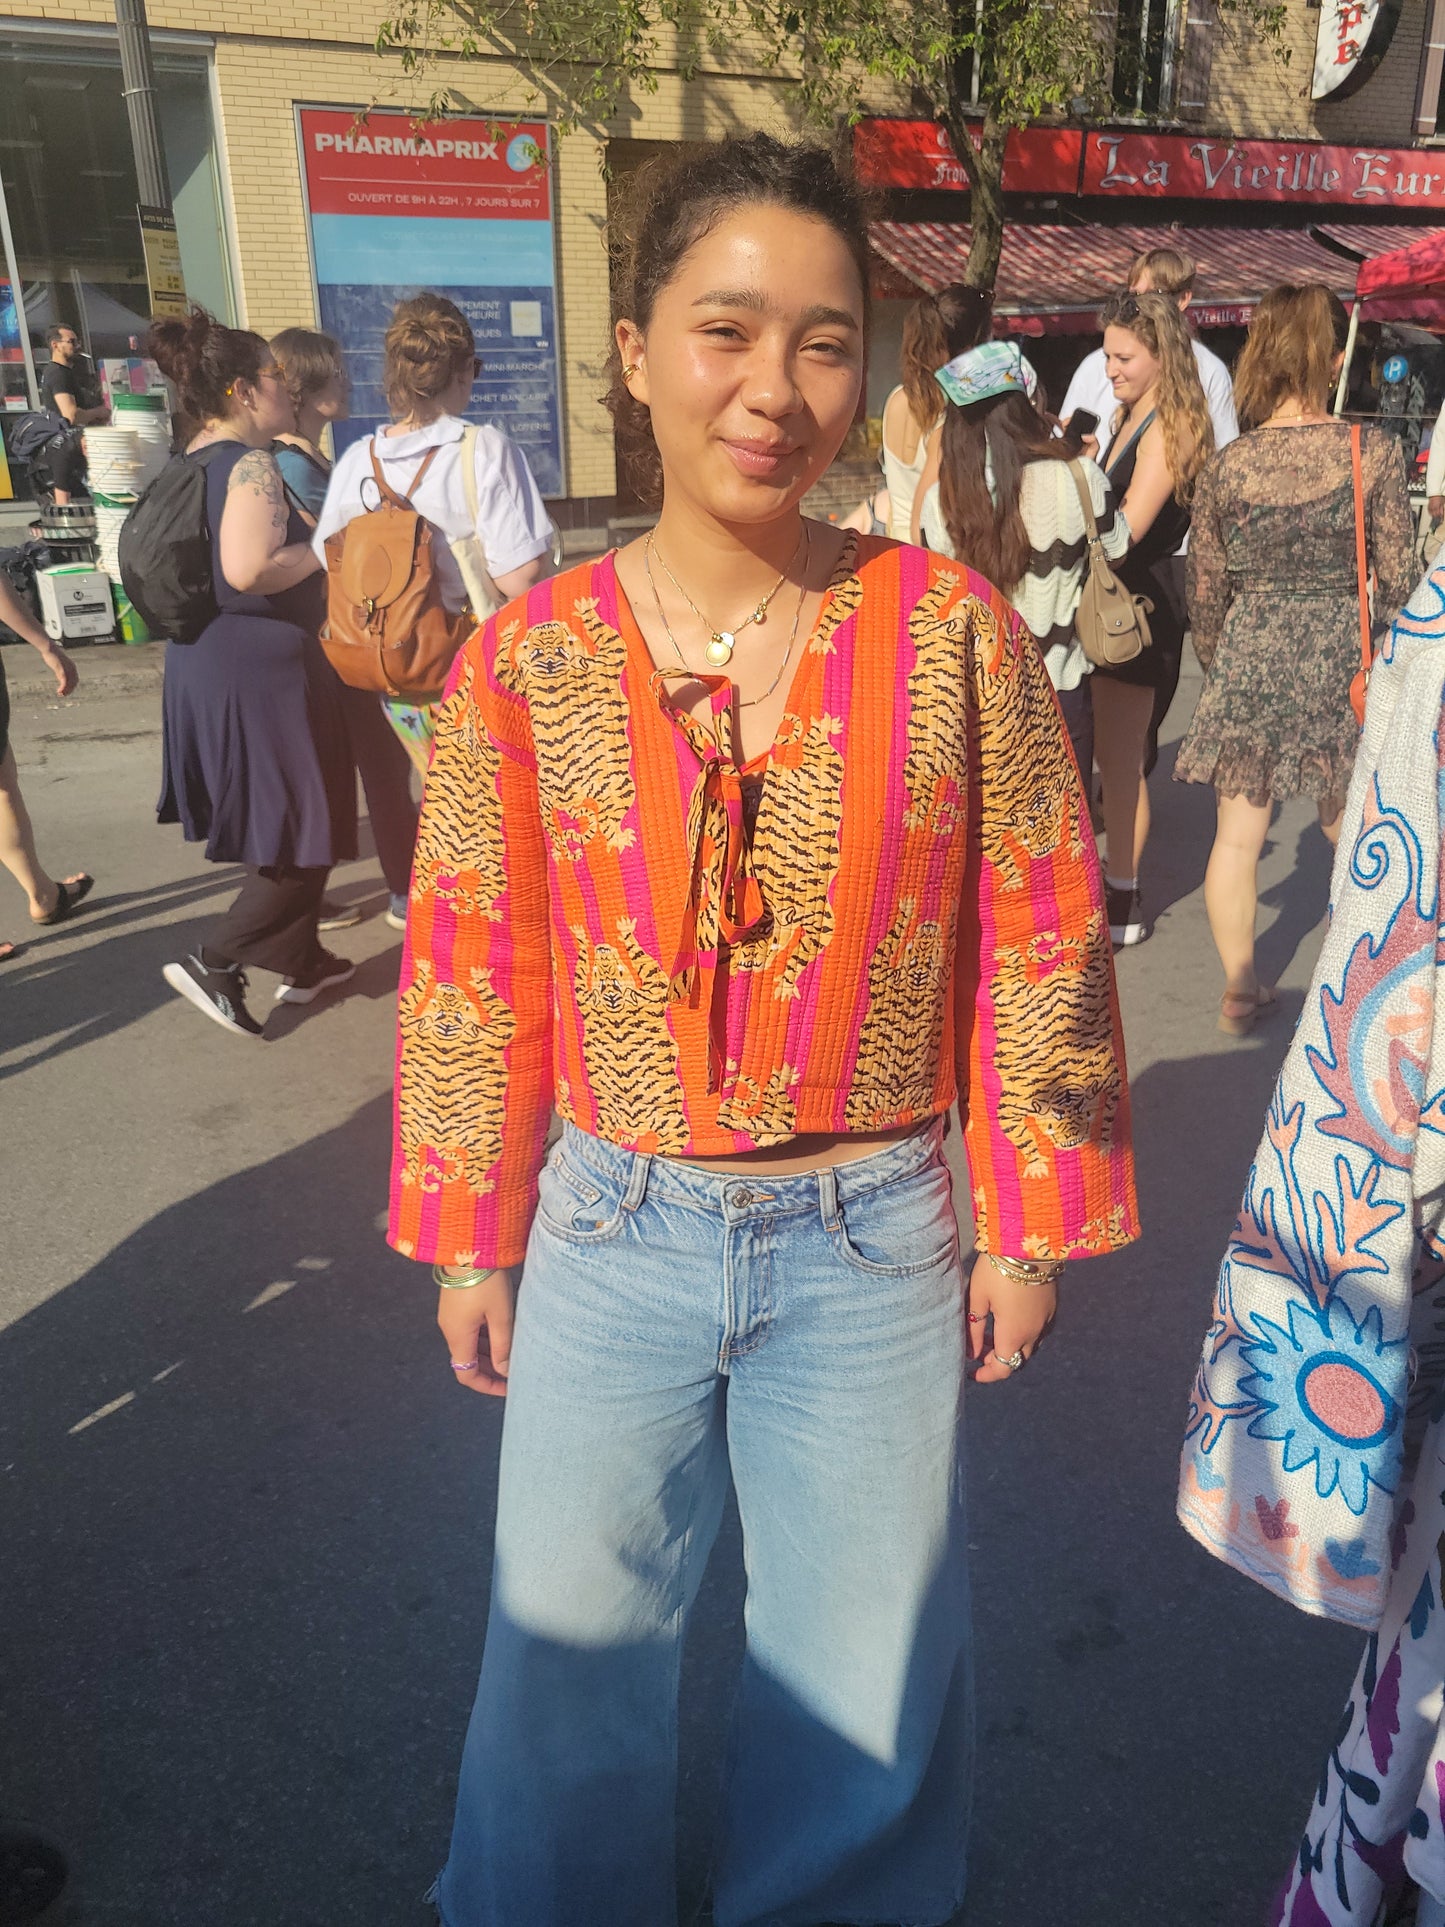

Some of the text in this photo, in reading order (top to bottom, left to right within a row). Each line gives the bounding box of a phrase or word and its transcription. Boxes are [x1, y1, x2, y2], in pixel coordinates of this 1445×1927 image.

[314, 132, 500, 161] PHARMAPRIX
[1096, 136, 1445, 199] La Vieille Eur
[348, 192, 393, 204] OUVERT
[395, 194, 410, 204] DE
[437, 196, 459, 206] 22H
[465, 196, 473, 206] 7
[474, 197, 509, 208] JOURS
[510, 198, 531, 208] SUR
[533, 199, 540, 209] 7
[1388, 359, 1402, 378] P
